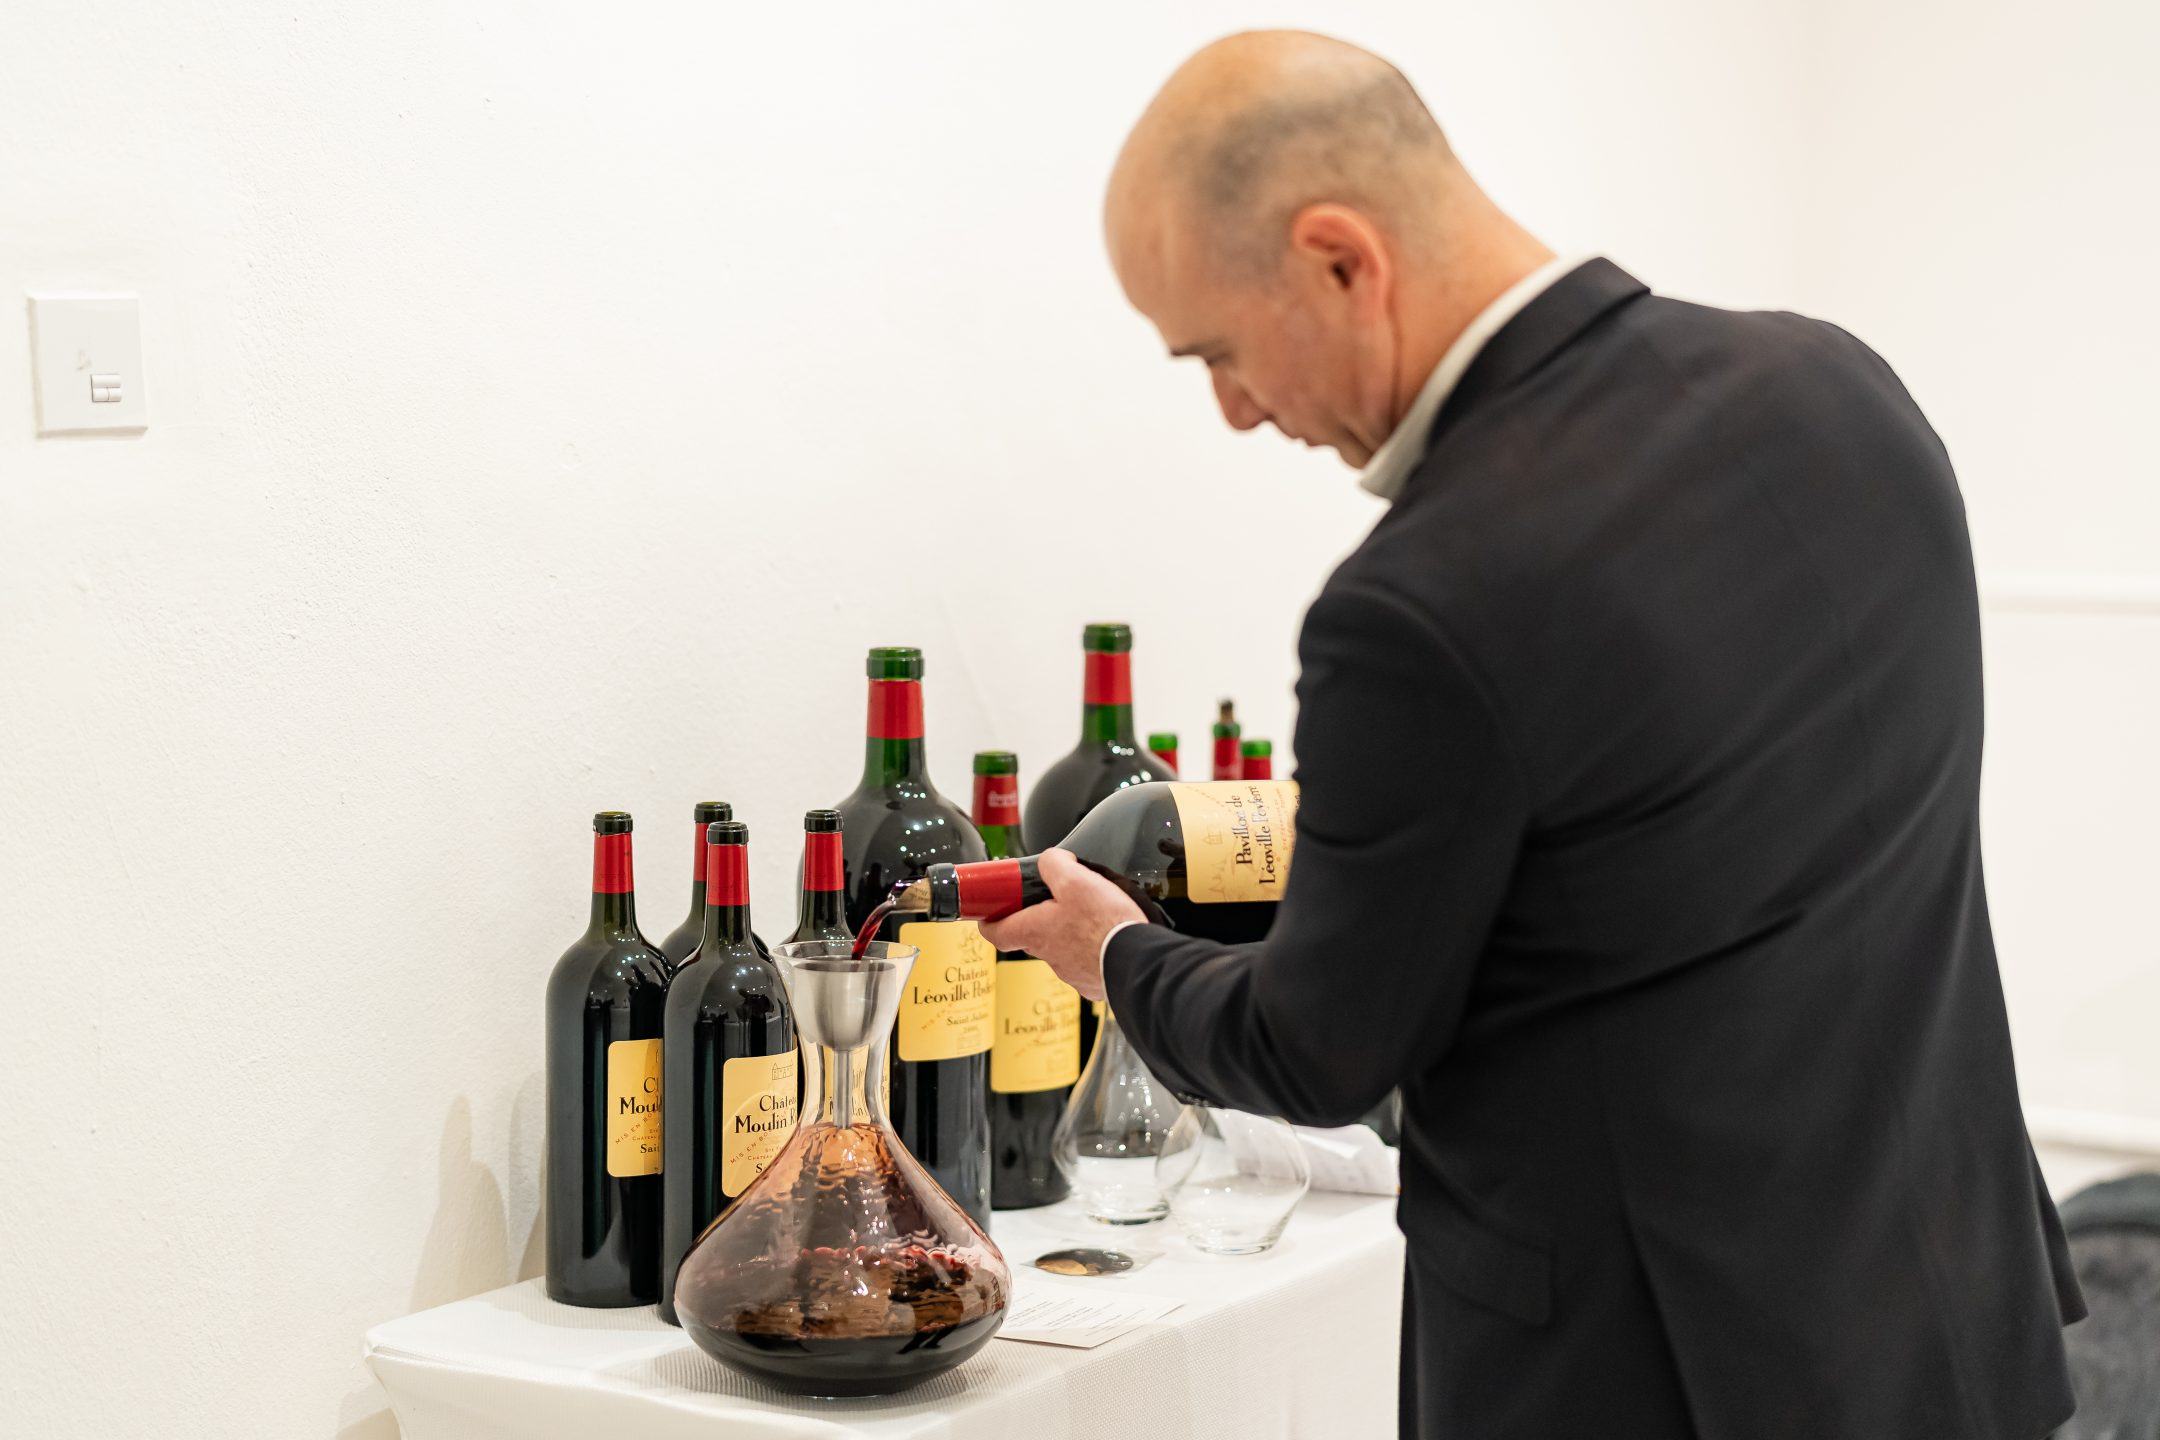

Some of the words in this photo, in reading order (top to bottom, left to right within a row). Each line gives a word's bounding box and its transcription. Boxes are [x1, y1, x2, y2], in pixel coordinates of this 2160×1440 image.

[1225, 795, 1243, 808] de
[1256, 825, 1276, 885] Léoville
[913, 984, 970, 1005] Léoville
[734, 1113, 788, 1134] Moulin
